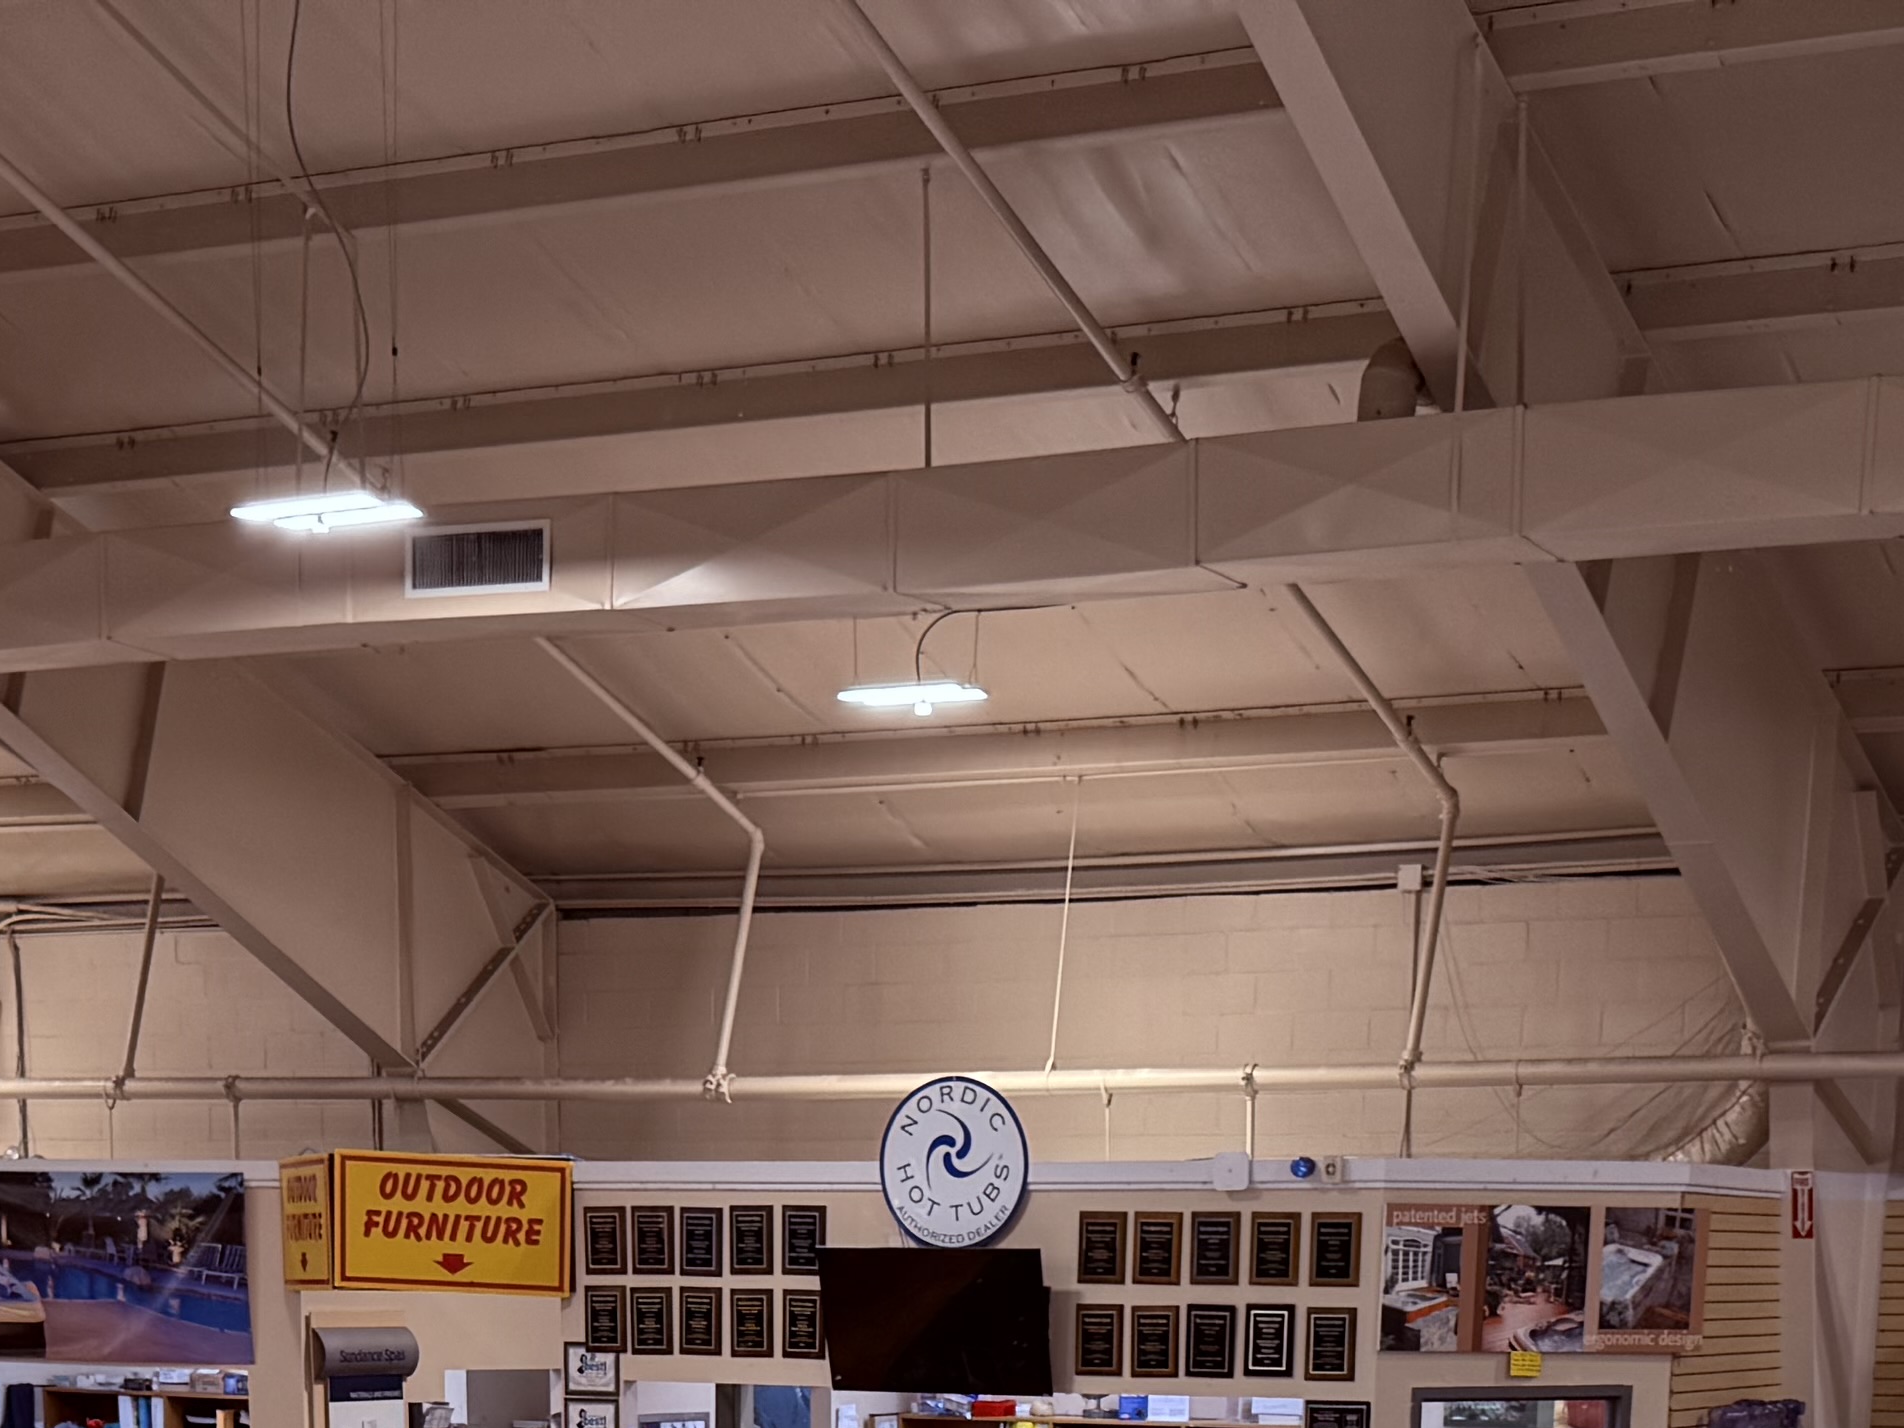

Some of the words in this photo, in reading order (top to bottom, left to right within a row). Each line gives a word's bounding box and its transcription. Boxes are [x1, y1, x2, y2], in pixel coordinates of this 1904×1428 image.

[900, 1085, 1006, 1136] NORDIC
[379, 1171, 528, 1210] OUTDOOR
[896, 1163, 941, 1217] HOT
[949, 1163, 1010, 1222] TUBS
[363, 1209, 544, 1248] FURNITURE
[897, 1205, 965, 1245] AUTHORIZED
[967, 1204, 1010, 1242] DEALER
[1392, 1208, 1457, 1225] patented
[1460, 1207, 1487, 1225] jets
[1584, 1331, 1656, 1351] ergonomic
[1658, 1328, 1704, 1351] design
